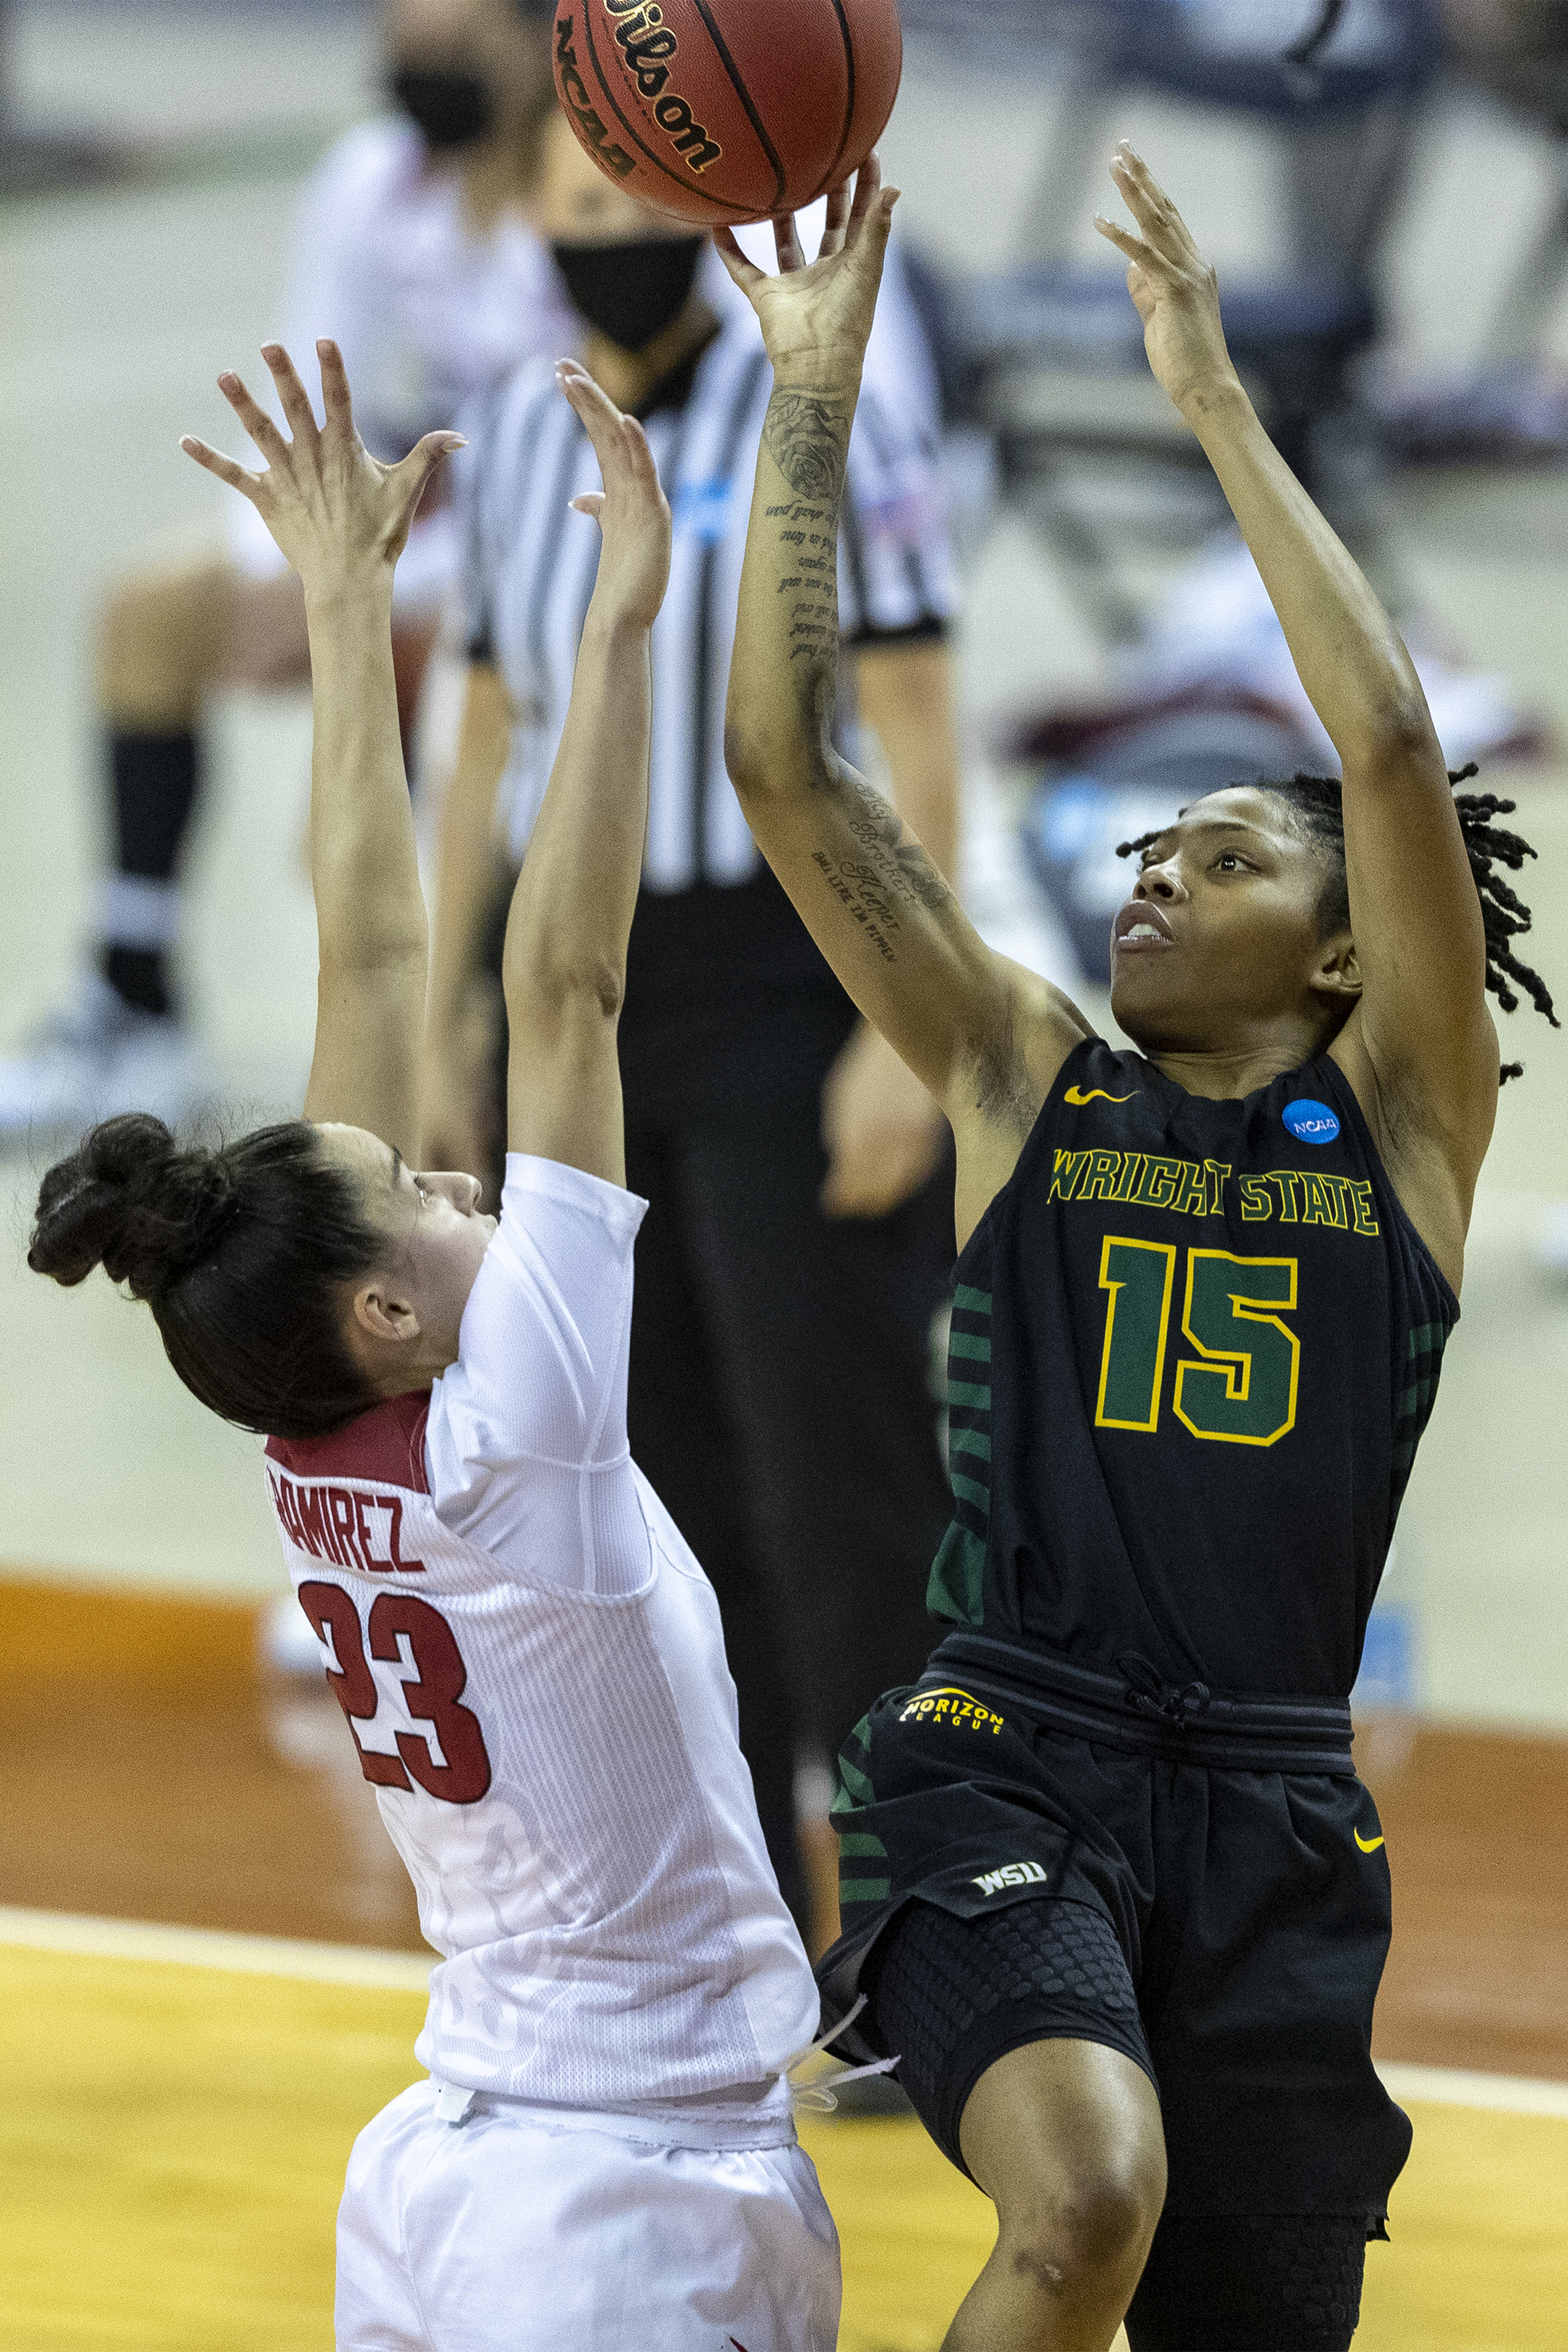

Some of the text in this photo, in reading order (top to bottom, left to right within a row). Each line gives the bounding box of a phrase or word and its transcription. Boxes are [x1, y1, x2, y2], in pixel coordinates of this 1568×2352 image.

[557, 16, 637, 177] NCAA
[840, 862, 901, 931] Keeper
[849, 821, 916, 902] Brothers
[1294, 1119, 1337, 1134] NCAA
[1047, 1149, 1379, 1236] WRIGHT STATE
[1094, 1234, 1301, 1447] 15
[298, 1581, 492, 1805] 23
[904, 1699, 1004, 1725] HORIZON
[971, 1861, 1047, 1896] WSU
